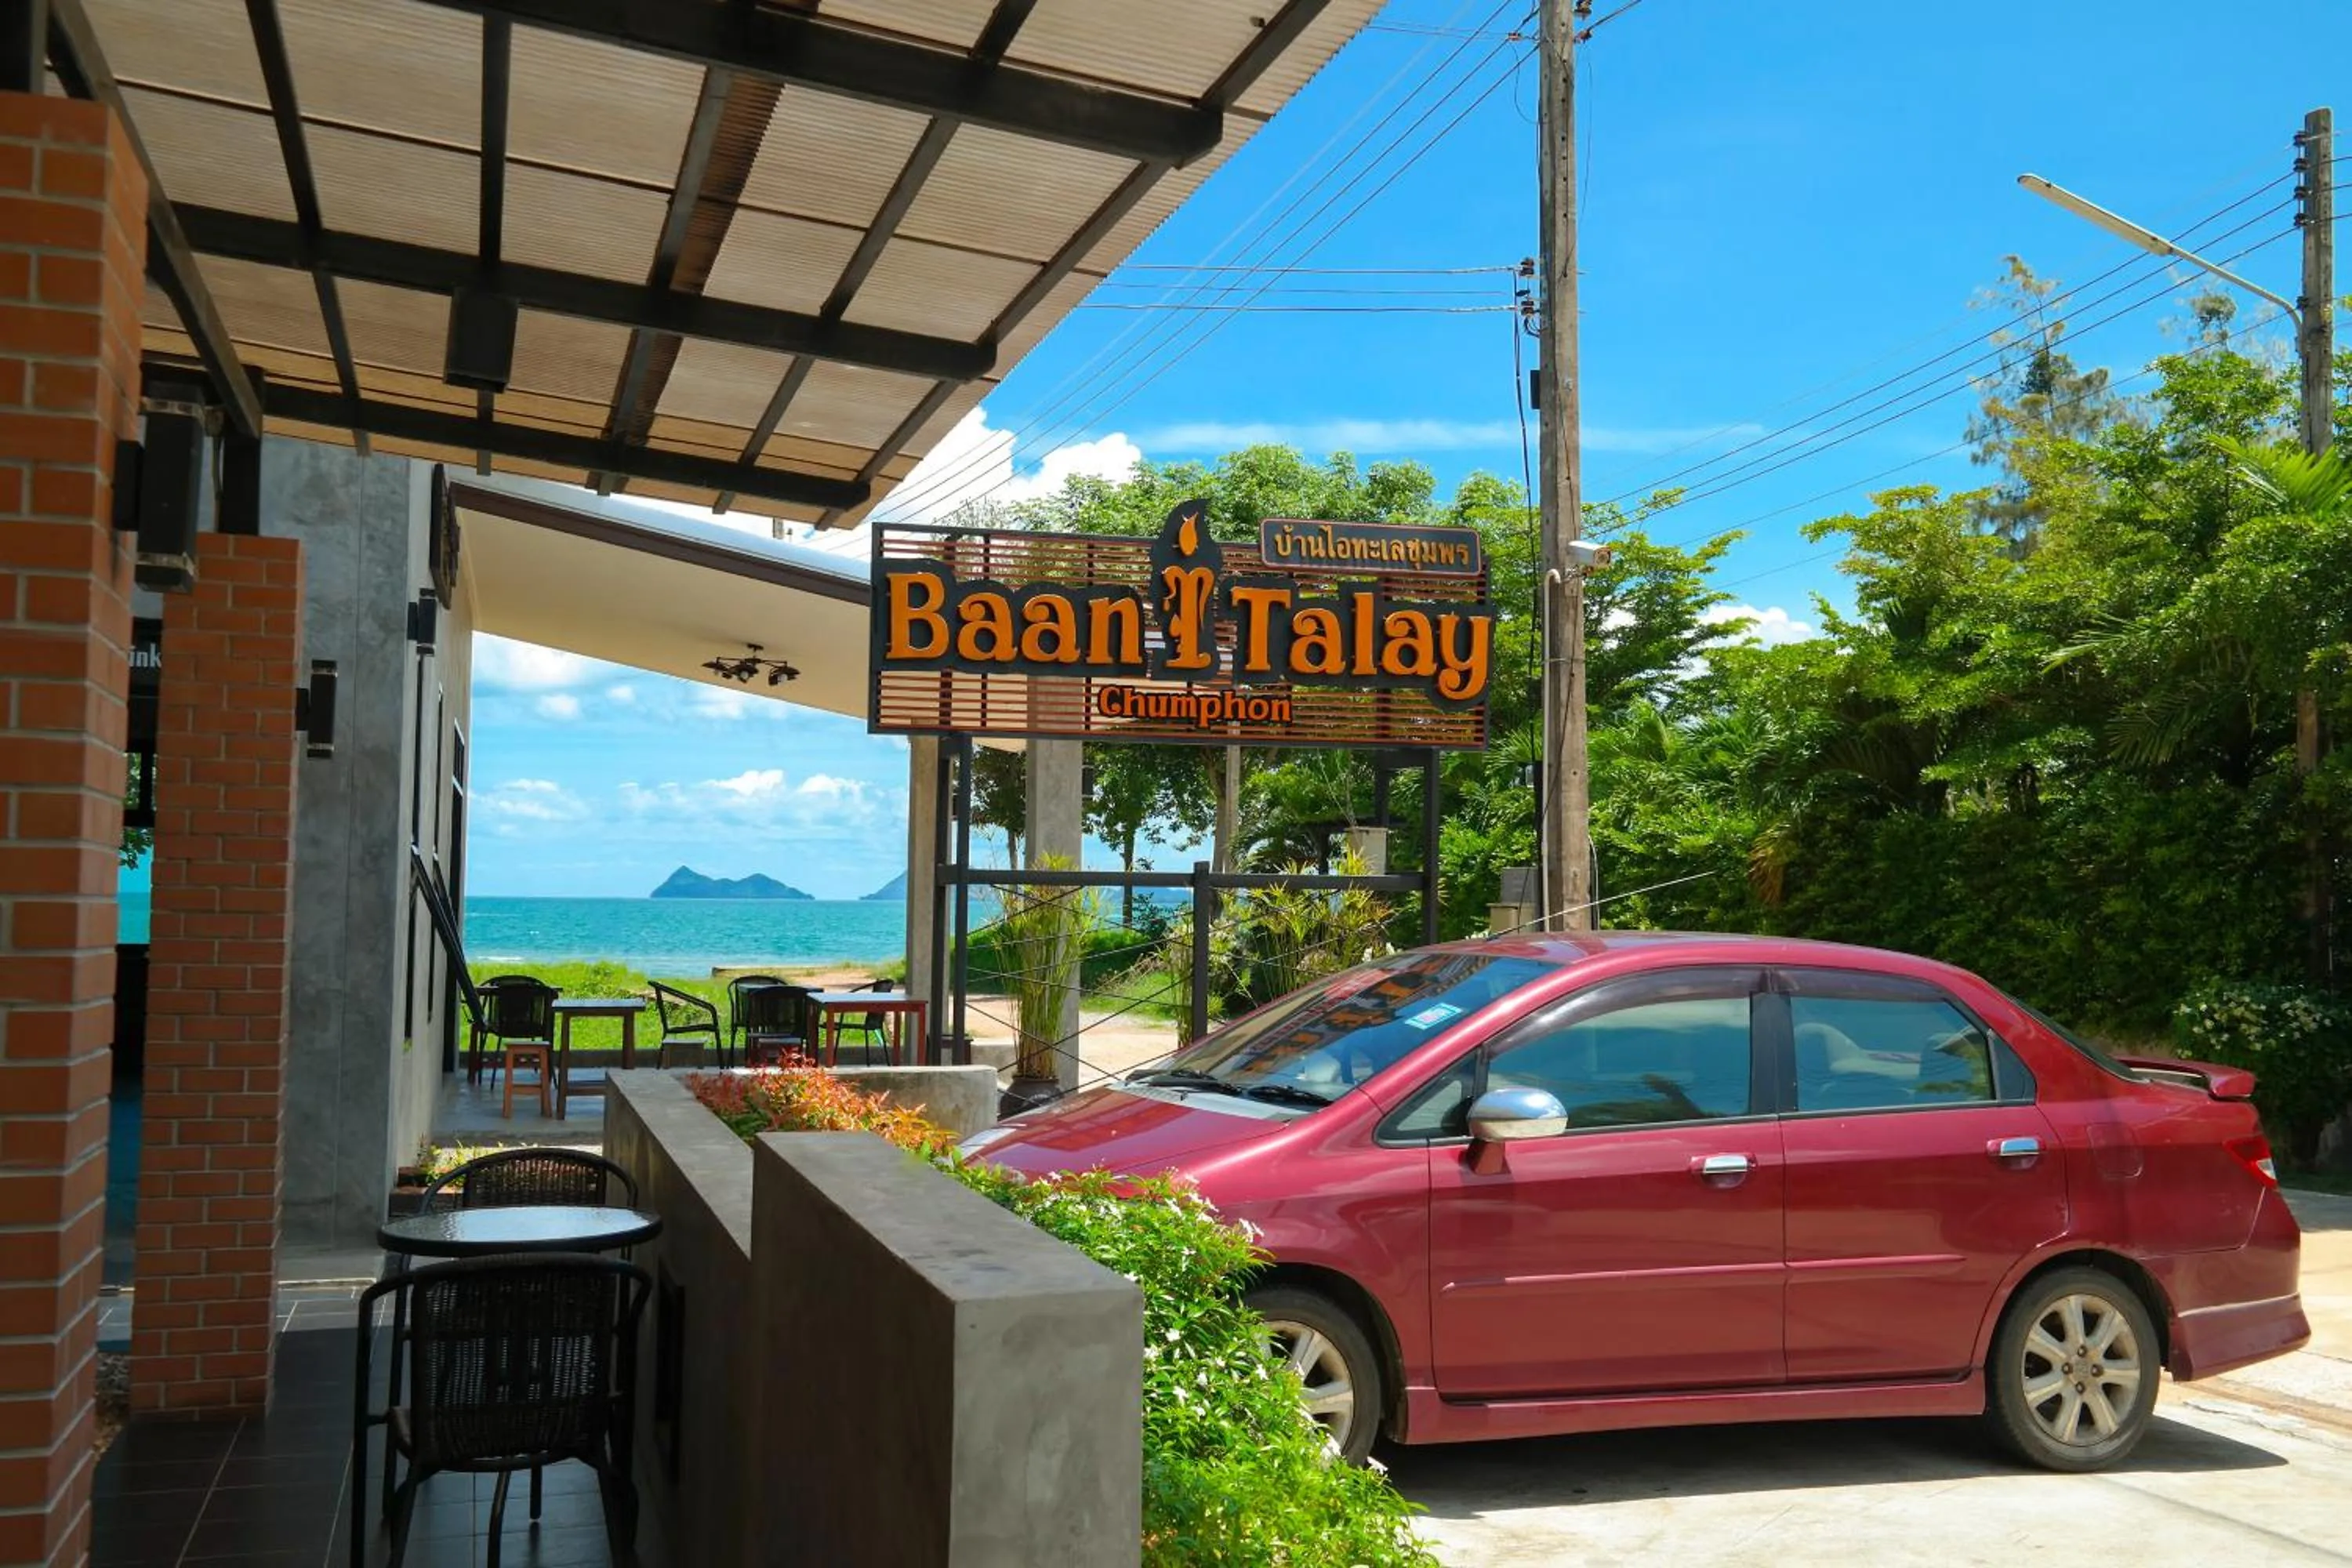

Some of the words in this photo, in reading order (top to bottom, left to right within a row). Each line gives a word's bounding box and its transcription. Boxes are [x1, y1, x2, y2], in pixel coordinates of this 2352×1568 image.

[1274, 524, 1470, 570] บ้านไอทะเลชุมพร
[886, 572, 1143, 664] Baan
[1232, 586, 1490, 701] Talay
[1099, 686, 1291, 728] Chumphon
